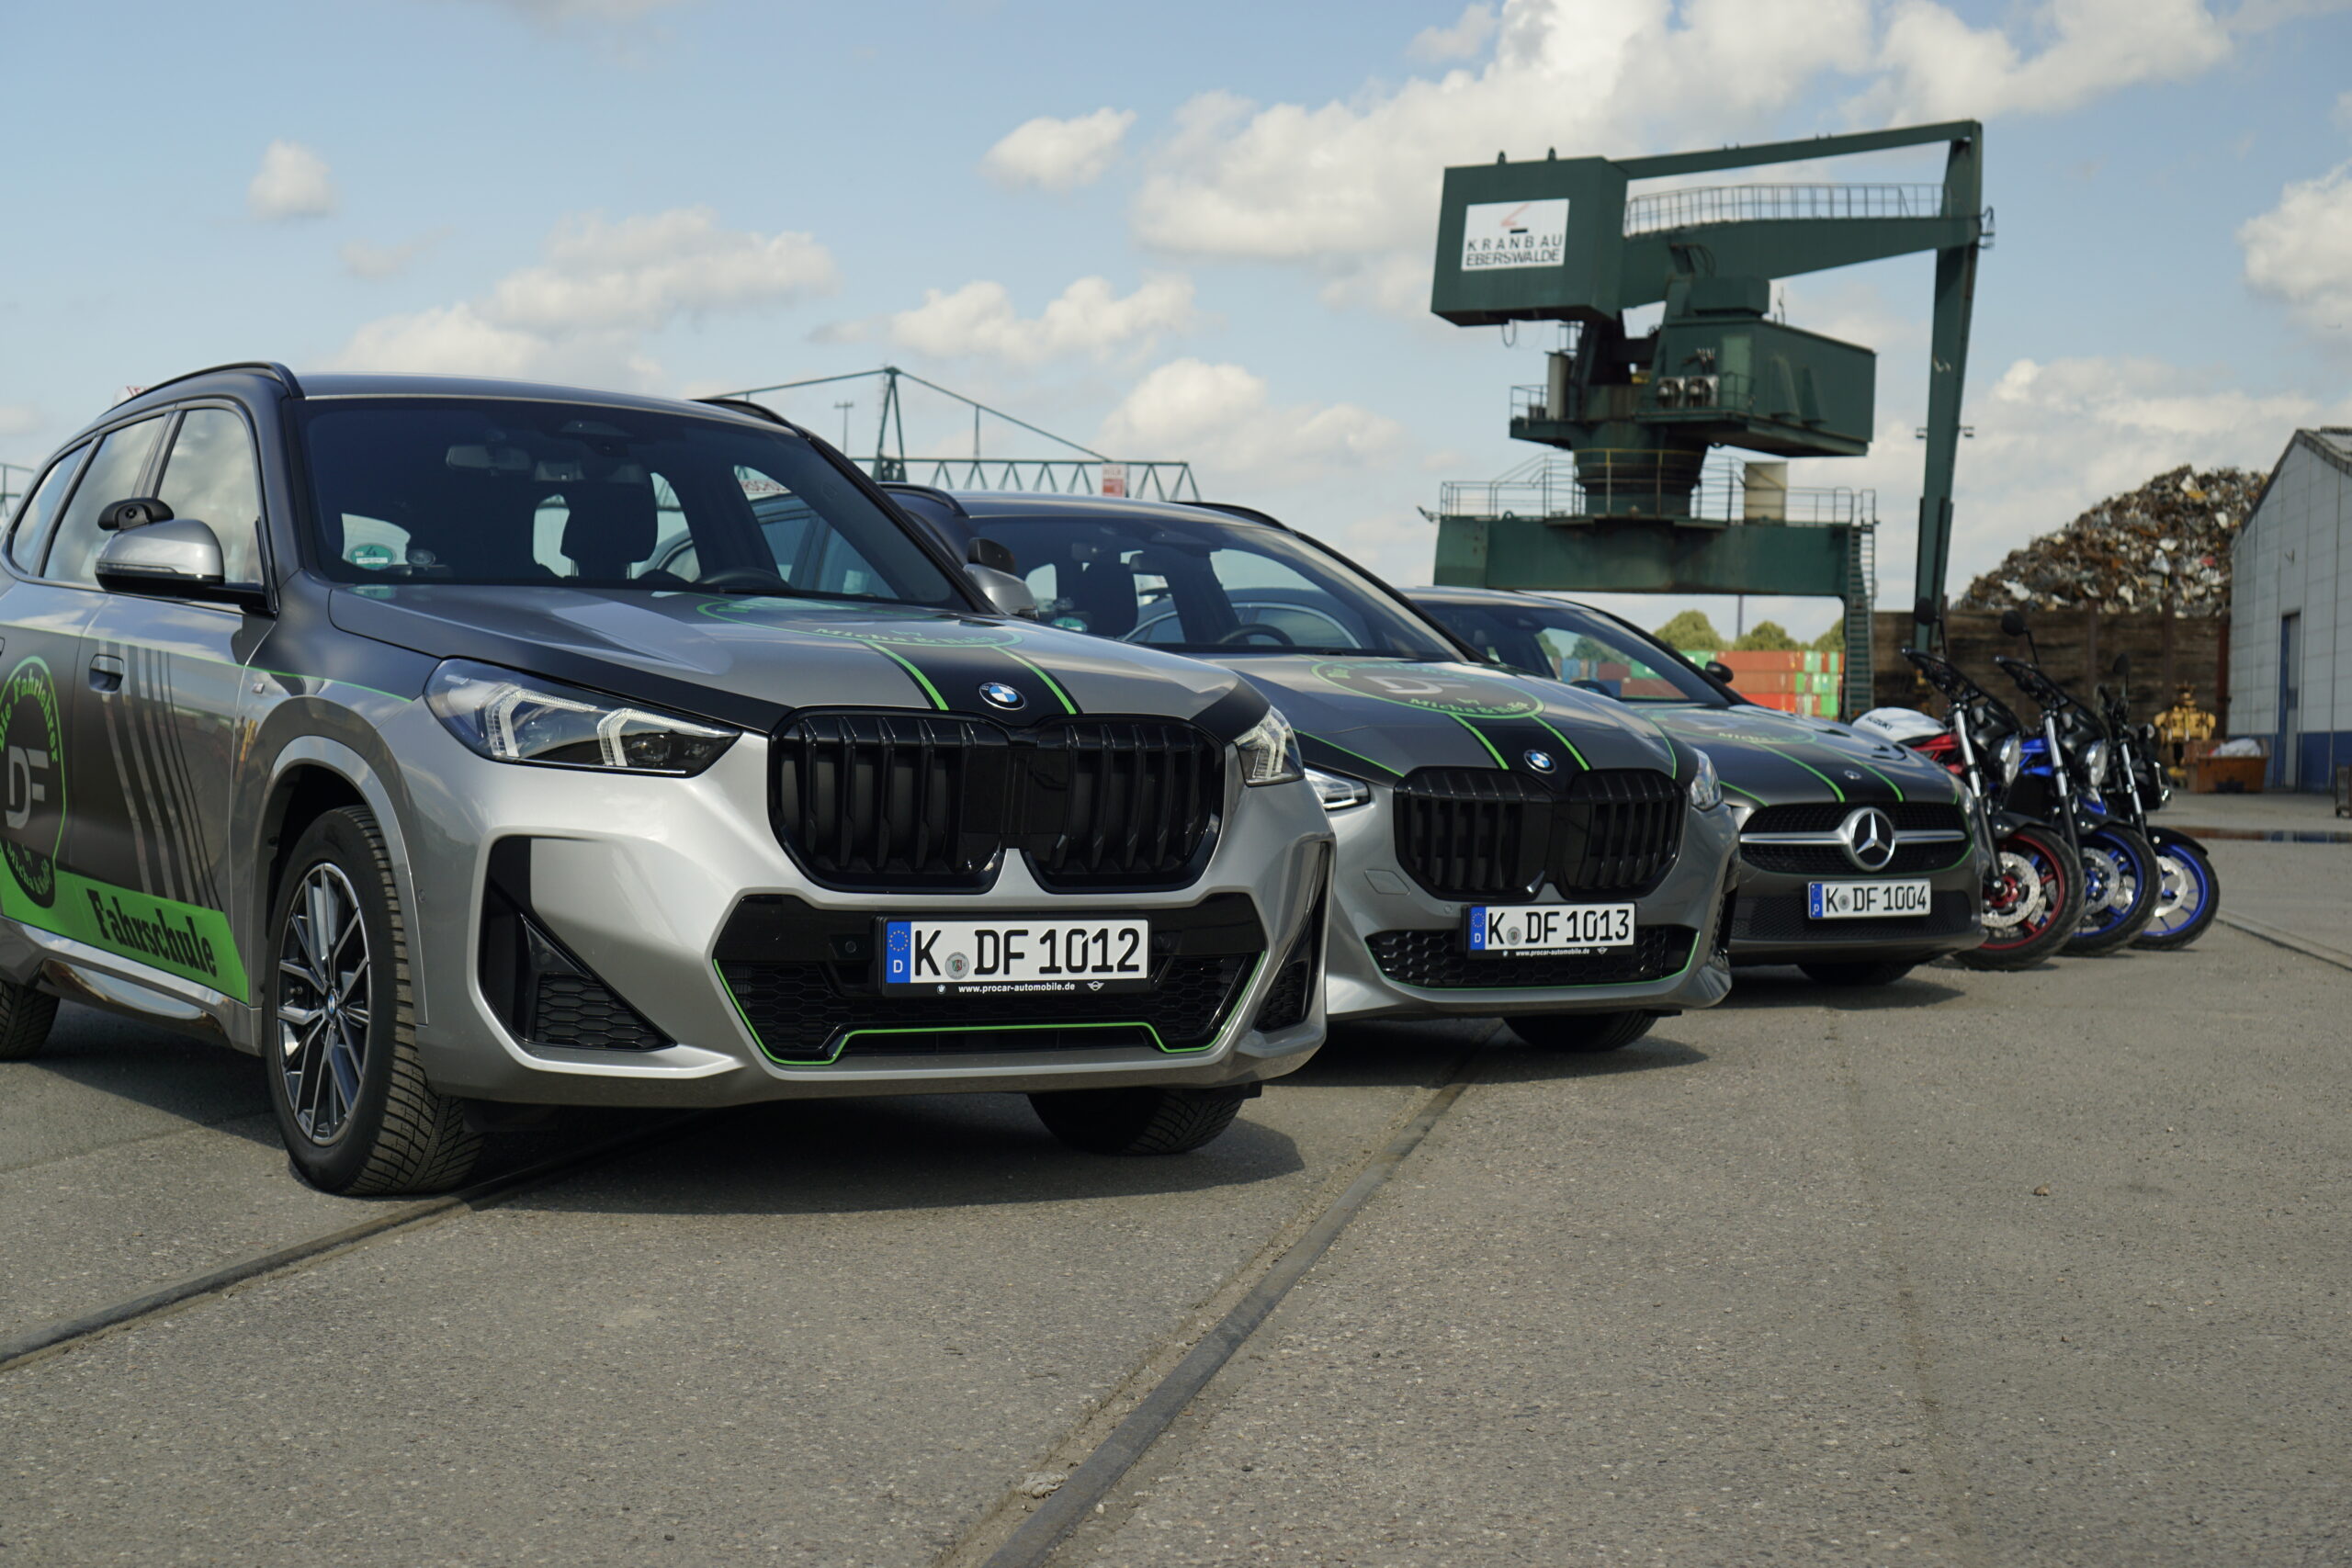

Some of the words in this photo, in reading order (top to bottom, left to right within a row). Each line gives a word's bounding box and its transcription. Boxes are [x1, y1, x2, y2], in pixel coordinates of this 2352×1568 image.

[1468, 234, 1562, 252] KRANBAU
[1466, 249, 1559, 265] EBERSWALDE
[14, 668, 58, 762] Fahrlehrer
[1826, 887, 1838, 913] K
[1852, 887, 1879, 912] DF
[1883, 886, 1927, 911] 1004
[86, 888, 217, 978] Fahrschule
[1488, 912, 1505, 944] K
[1525, 911, 1560, 943] DF
[1566, 909, 1630, 942] 1013
[1474, 933, 1481, 943] D
[915, 930, 942, 976] K
[974, 930, 1029, 975] DF
[1039, 928, 1140, 974] 1012
[1516, 948, 1590, 957] www.procar-automobile.de
[893, 960, 903, 973] D
[958, 982, 1075, 994] www.procar-automobile.de
